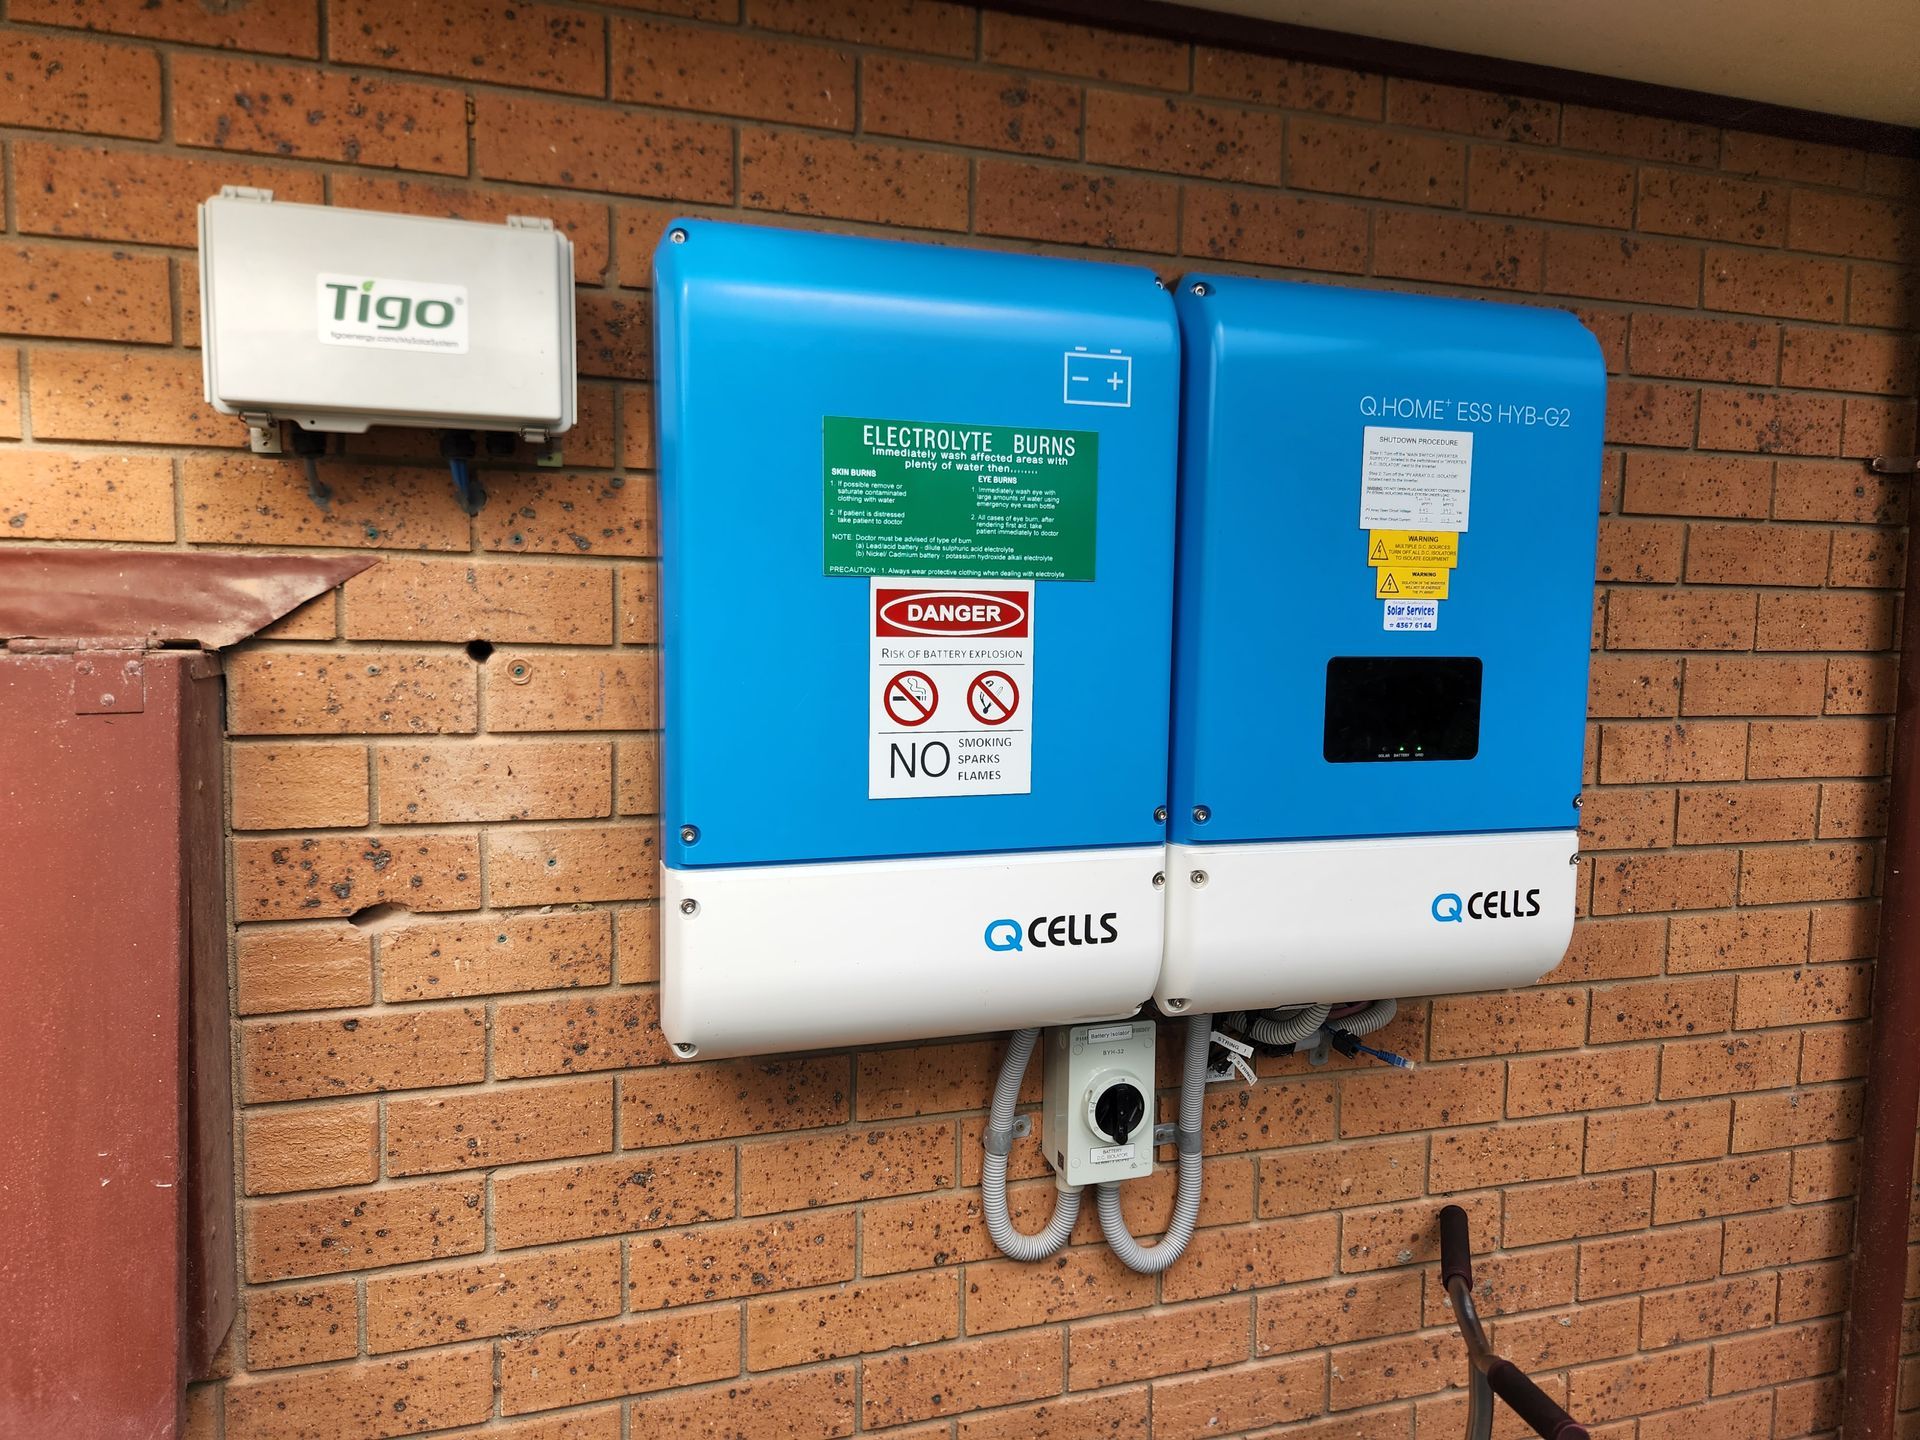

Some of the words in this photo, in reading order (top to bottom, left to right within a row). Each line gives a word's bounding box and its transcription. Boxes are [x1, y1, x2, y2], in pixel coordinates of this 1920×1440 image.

[326, 280, 454, 330] Tigo
[1458, 402, 1492, 422] ESS
[1498, 404, 1570, 428] HYB-G2
[864, 425, 992, 452] ELECTROLYTE
[1014, 434, 1076, 456] BURNS
[872, 447, 936, 460] Immediately
[941, 452, 966, 460] wash
[970, 454, 1012, 463] affected
[1016, 456, 1044, 464] areas
[1048, 457, 1068, 465] with
[905, 460, 937, 471] plenty
[956, 463, 983, 472] water
[850, 469, 876, 477] BURNS
[908, 604, 1001, 622] DANGER
[1388, 606, 1405, 616] Solar
[1407, 606, 1434, 616] Services
[882, 648, 905, 659] RISK
[908, 650, 921, 658] OF
[924, 650, 966, 659] BATTERY
[969, 650, 1023, 659] EXPLOSION
[958, 738, 1012, 747] SMOKING
[890, 741, 950, 779] NO
[958, 754, 1000, 764] SPARKS
[958, 770, 1001, 780] FLAMES
[1218, 1037, 1240, 1050] STRING
[1237, 1061, 1253, 1080] STRING
